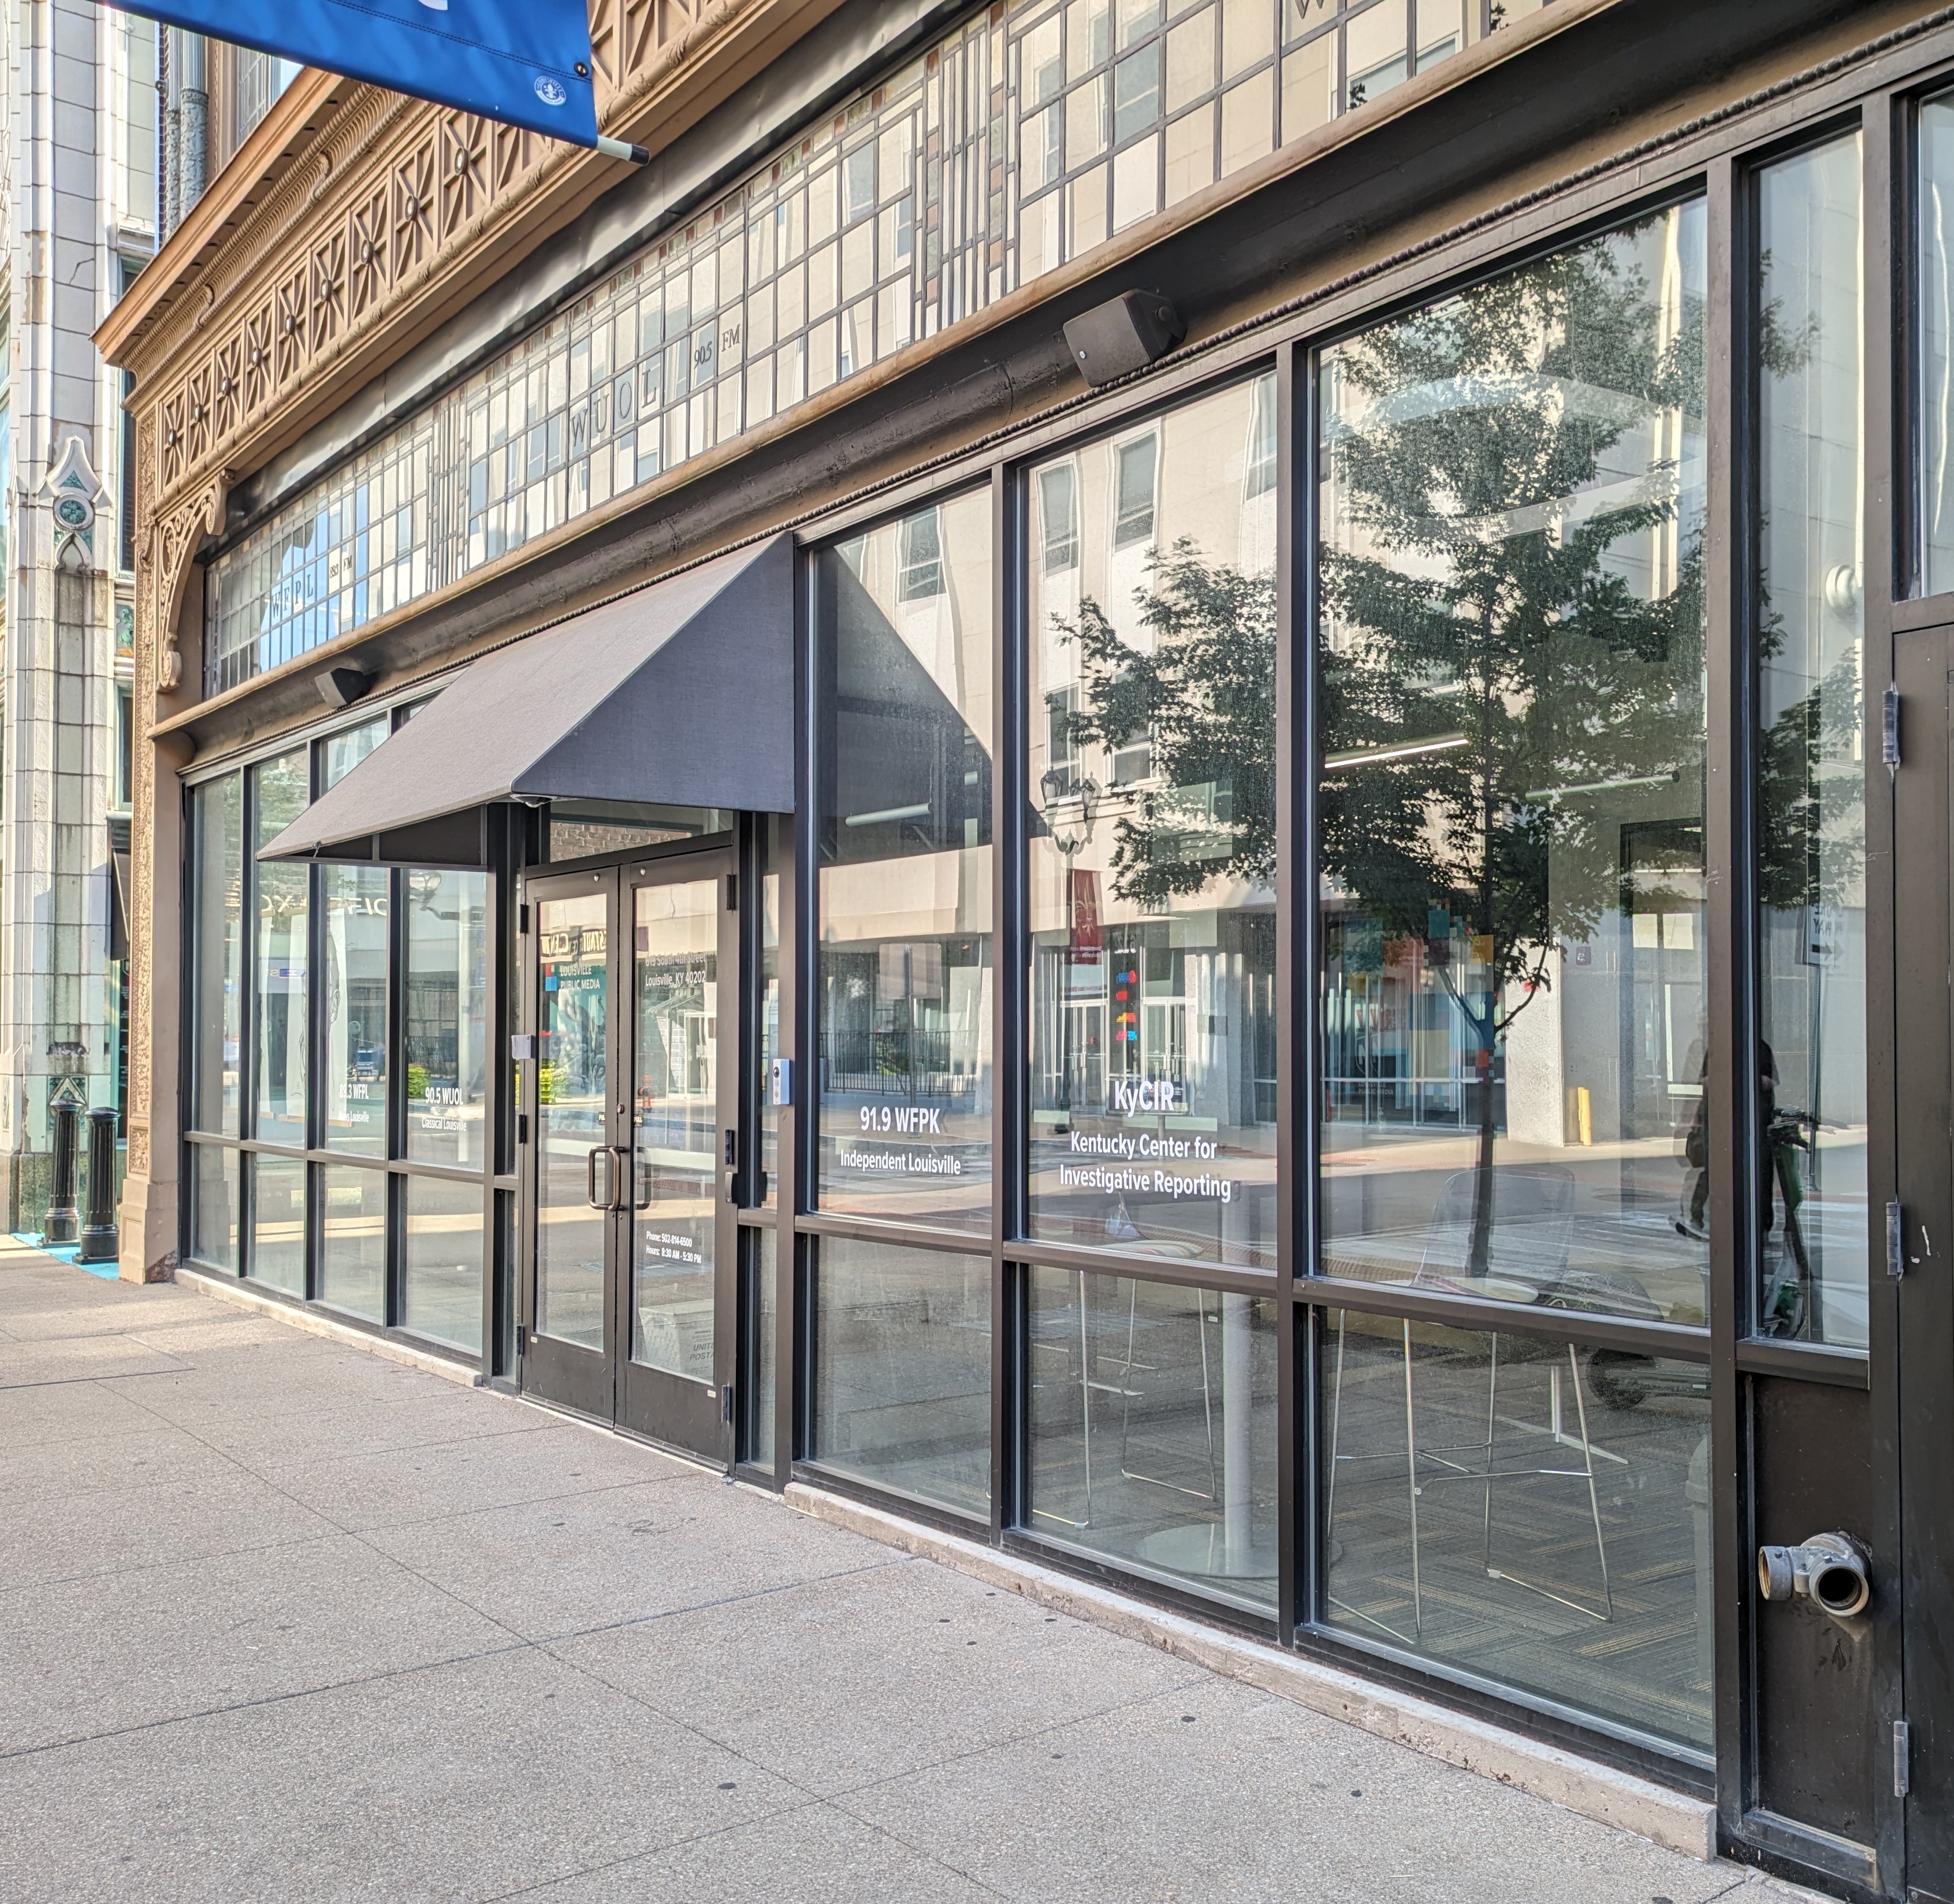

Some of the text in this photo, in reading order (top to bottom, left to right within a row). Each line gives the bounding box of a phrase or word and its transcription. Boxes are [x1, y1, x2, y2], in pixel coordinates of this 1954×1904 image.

[571, 369, 657, 447] WUOL
[721, 323, 740, 352] FM
[271, 574, 314, 619] WFPL
[343, 555, 352, 572] FM
[645, 951, 706, 966] 619 South 4th Street
[560, 966, 592, 976] LOUISVILLE
[675, 972, 684, 984] KY
[685, 970, 706, 984] 40202
[560, 979, 600, 990] PUBLIC MEDIA
[339, 1084, 369, 1099] 89.3 WFPL
[425, 1087, 464, 1105] 90.5 WUOL
[1115, 1080, 1174, 1117] KyCIR
[350, 1111, 370, 1123] Louisville
[422, 1116, 467, 1132] Classical Louisville
[860, 1106, 940, 1134] 91.9 WFPK
[1071, 1130, 1218, 1160] Kentucky Center for
[840, 1149, 961, 1175] Independent Louisville
[1060, 1163, 1231, 1203] Investigative Reporting
[646, 1230, 661, 1242] Phone:
[661, 1247, 672, 1258] 8:30
[672, 1250, 680, 1260] AM
[683, 1251, 693, 1263] 5:30
[694, 1253, 702, 1264] PM
